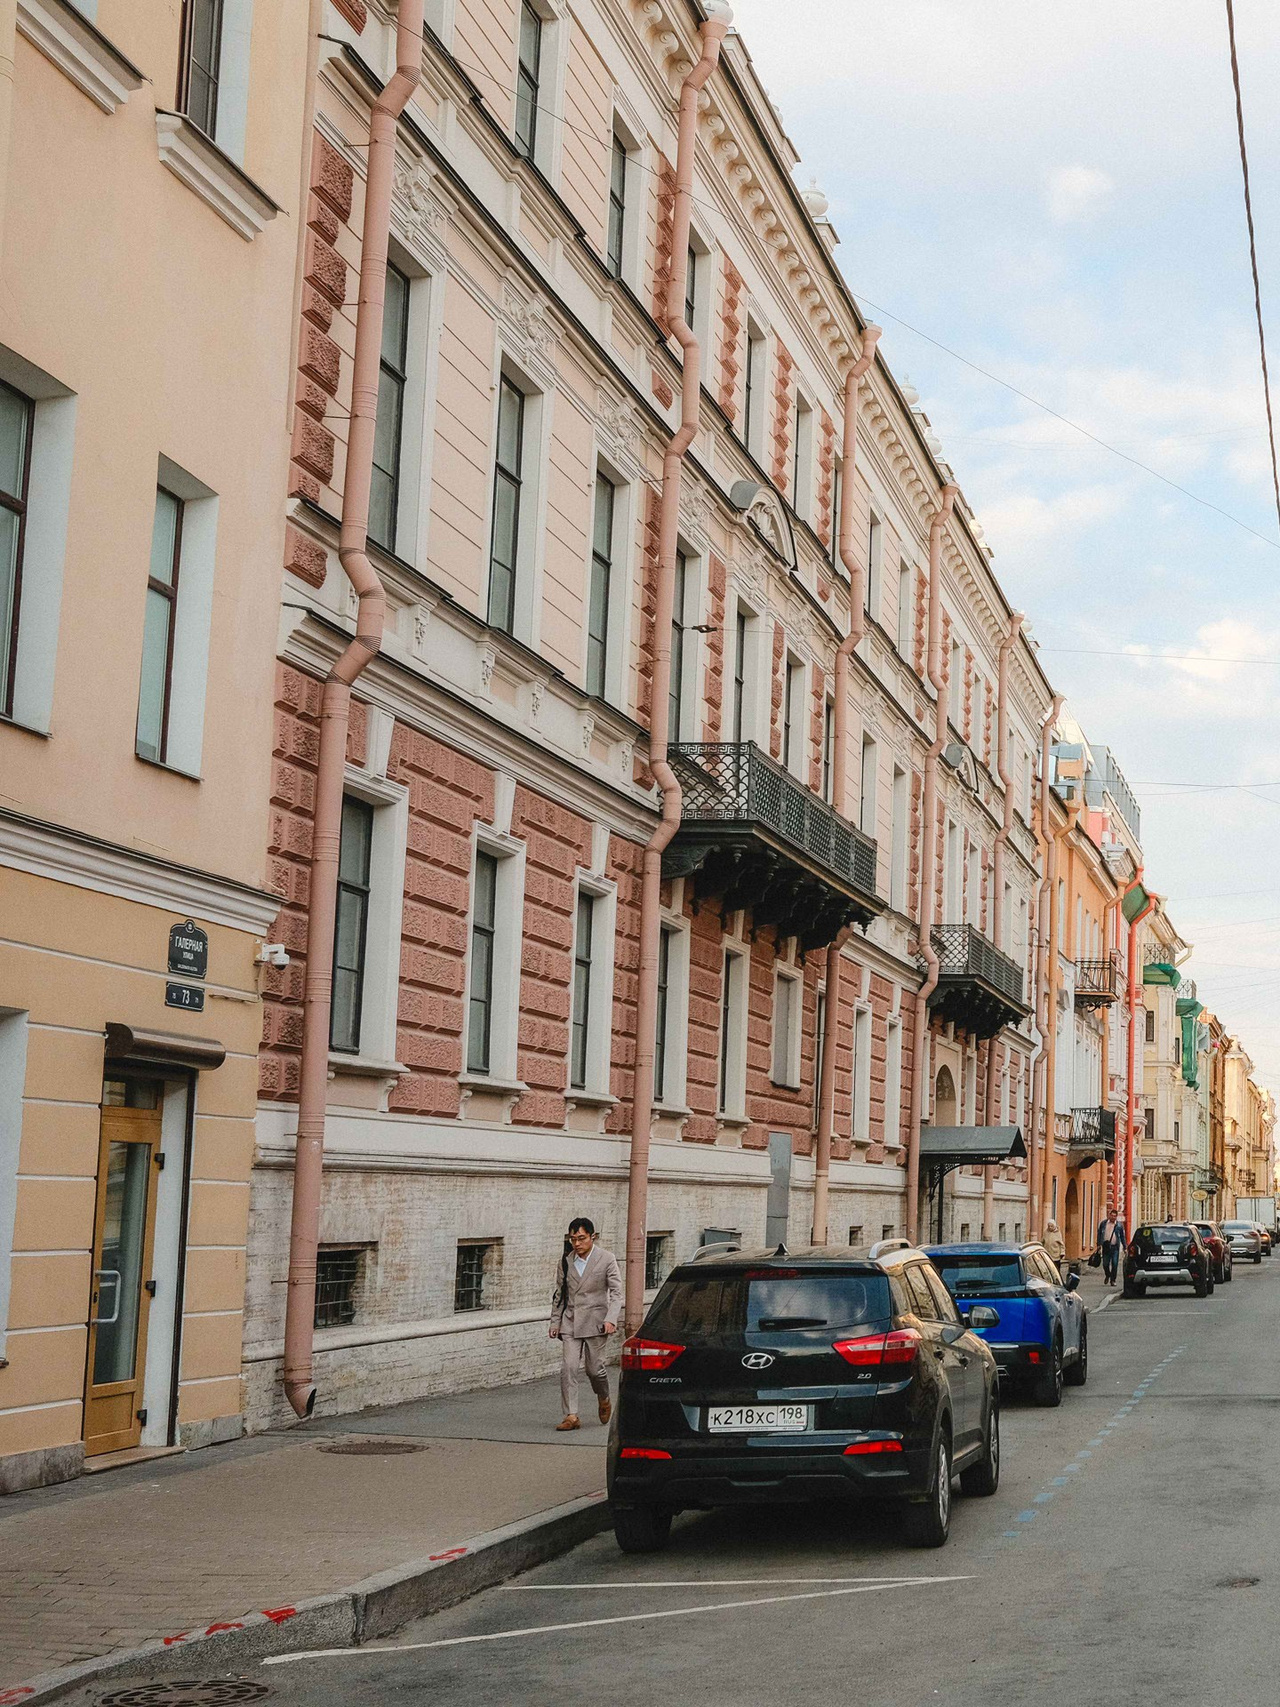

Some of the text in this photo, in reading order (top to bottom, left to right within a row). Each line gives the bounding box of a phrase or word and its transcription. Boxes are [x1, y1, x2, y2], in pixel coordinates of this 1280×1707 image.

[175, 936, 203, 953] ГАЛЕРНАЯ
[182, 989, 191, 1004] 73
[779, 1407, 803, 1419] 198
